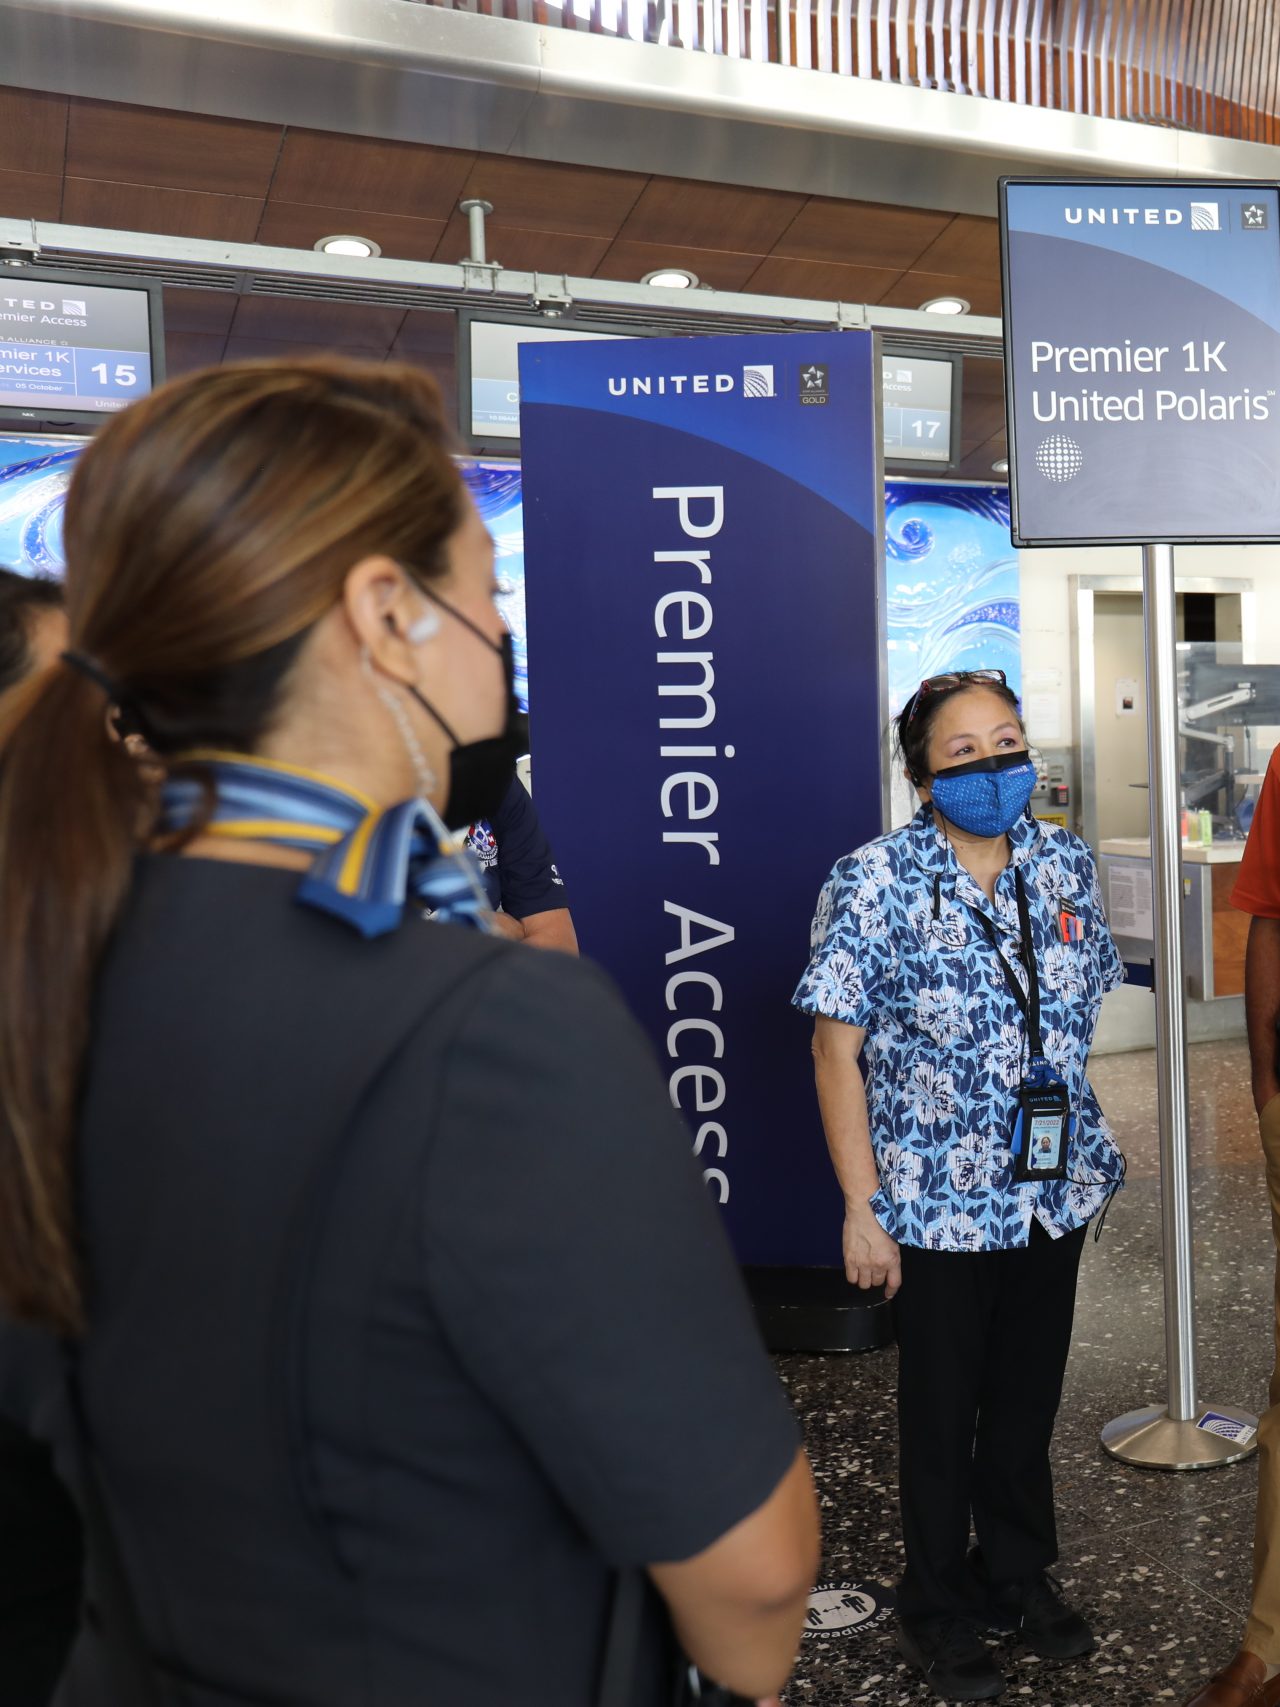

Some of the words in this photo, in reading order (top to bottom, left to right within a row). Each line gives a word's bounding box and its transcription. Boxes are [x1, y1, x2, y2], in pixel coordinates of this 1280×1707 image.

[1064, 207, 1183, 225] UNITED
[0, 311, 36, 323] mier
[40, 314, 87, 327] Access
[7, 336, 57, 346] ALLIANCE
[45, 351, 70, 363] 1K
[1031, 339, 1169, 373] Premier
[1182, 340, 1227, 373] 1K
[91, 362, 137, 386] 15
[29, 384, 62, 392] October
[607, 374, 735, 396] UNITED
[883, 382, 912, 392] Access
[802, 396, 826, 404] GOLD
[1032, 389, 1144, 422] United
[1156, 388, 1269, 421] Polaris
[911, 420, 941, 439] 17
[652, 485, 736, 865] Premier
[840, 1581, 863, 1591] by
[875, 1607, 895, 1621] out
